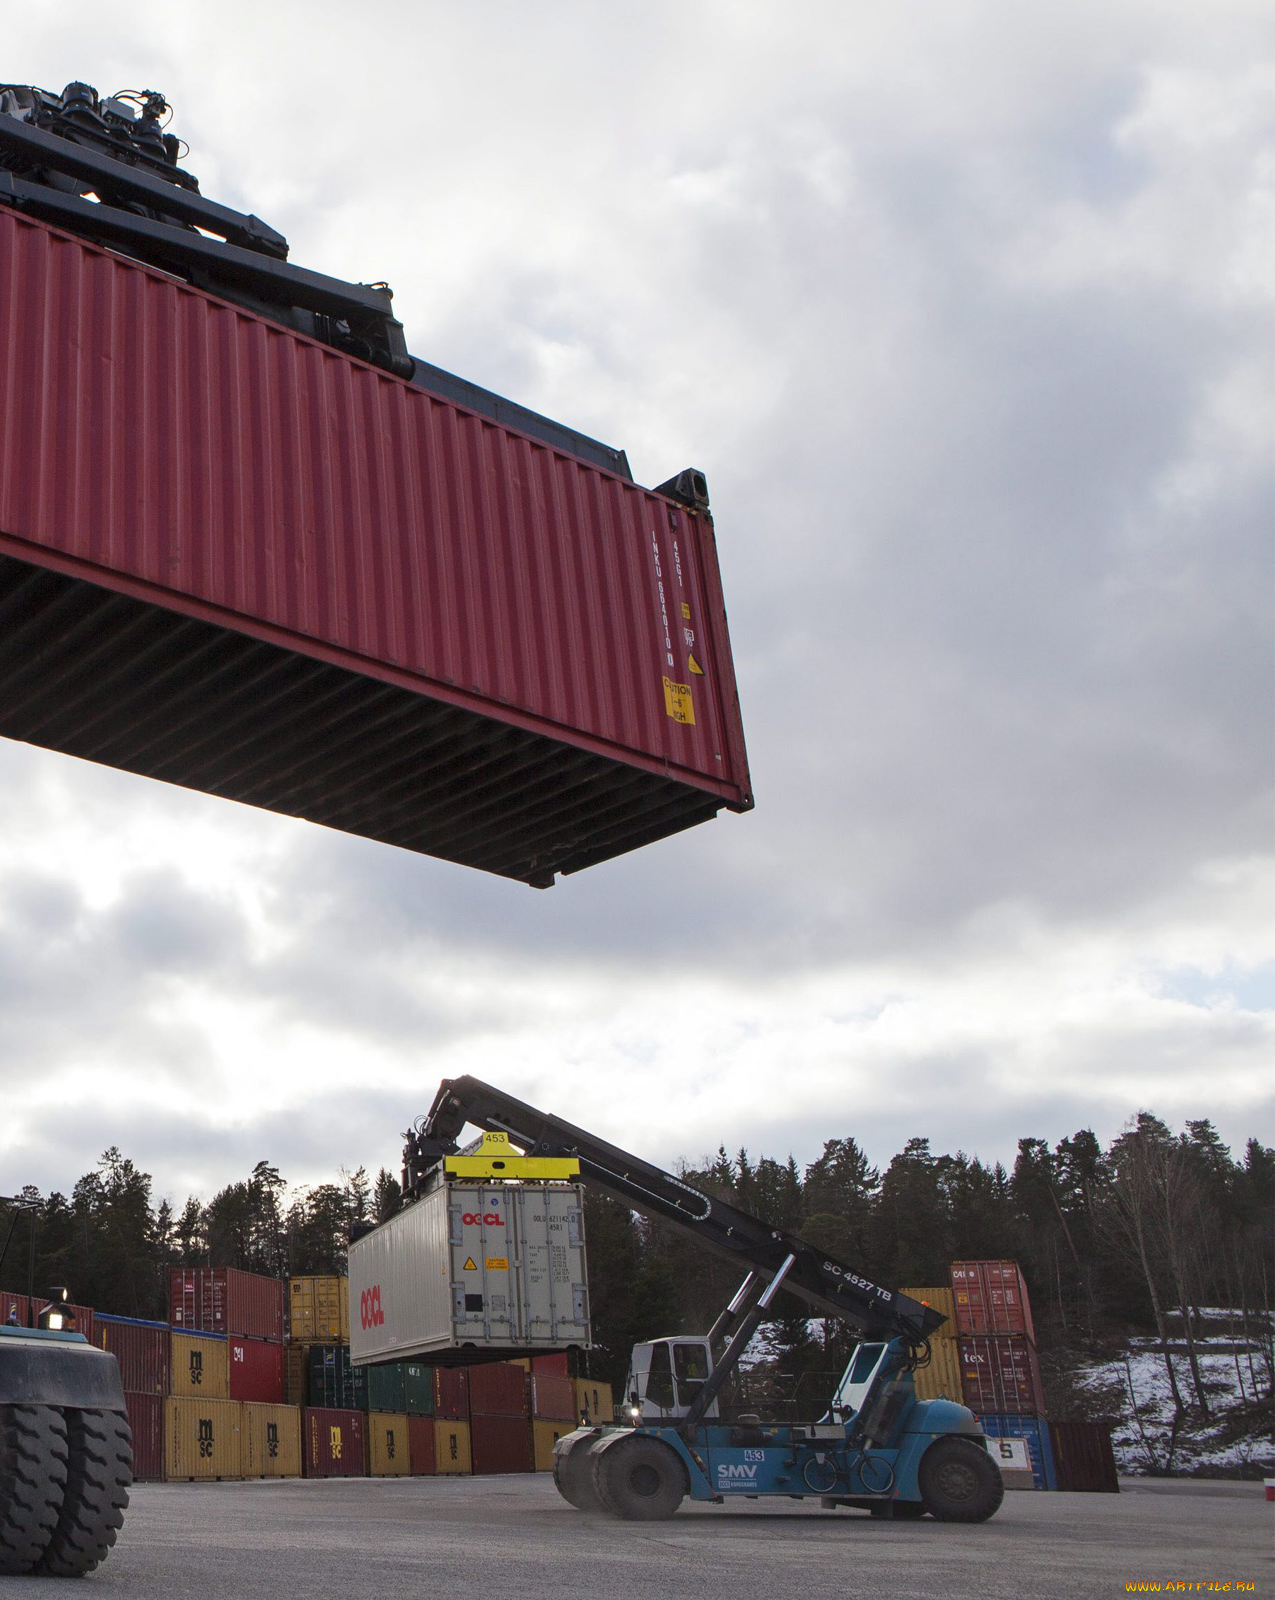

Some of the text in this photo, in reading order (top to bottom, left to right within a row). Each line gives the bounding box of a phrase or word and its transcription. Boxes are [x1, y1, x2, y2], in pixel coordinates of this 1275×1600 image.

[485, 1134, 505, 1143] 453
[462, 1212, 505, 1226] OOCL
[823, 1261, 892, 1301] SC 4527 TB
[360, 1284, 385, 1331] OOCL
[964, 1353, 985, 1363] tex
[745, 1450, 764, 1461] 453
[1000, 1443, 1013, 1459] S
[717, 1464, 758, 1478] SMV
